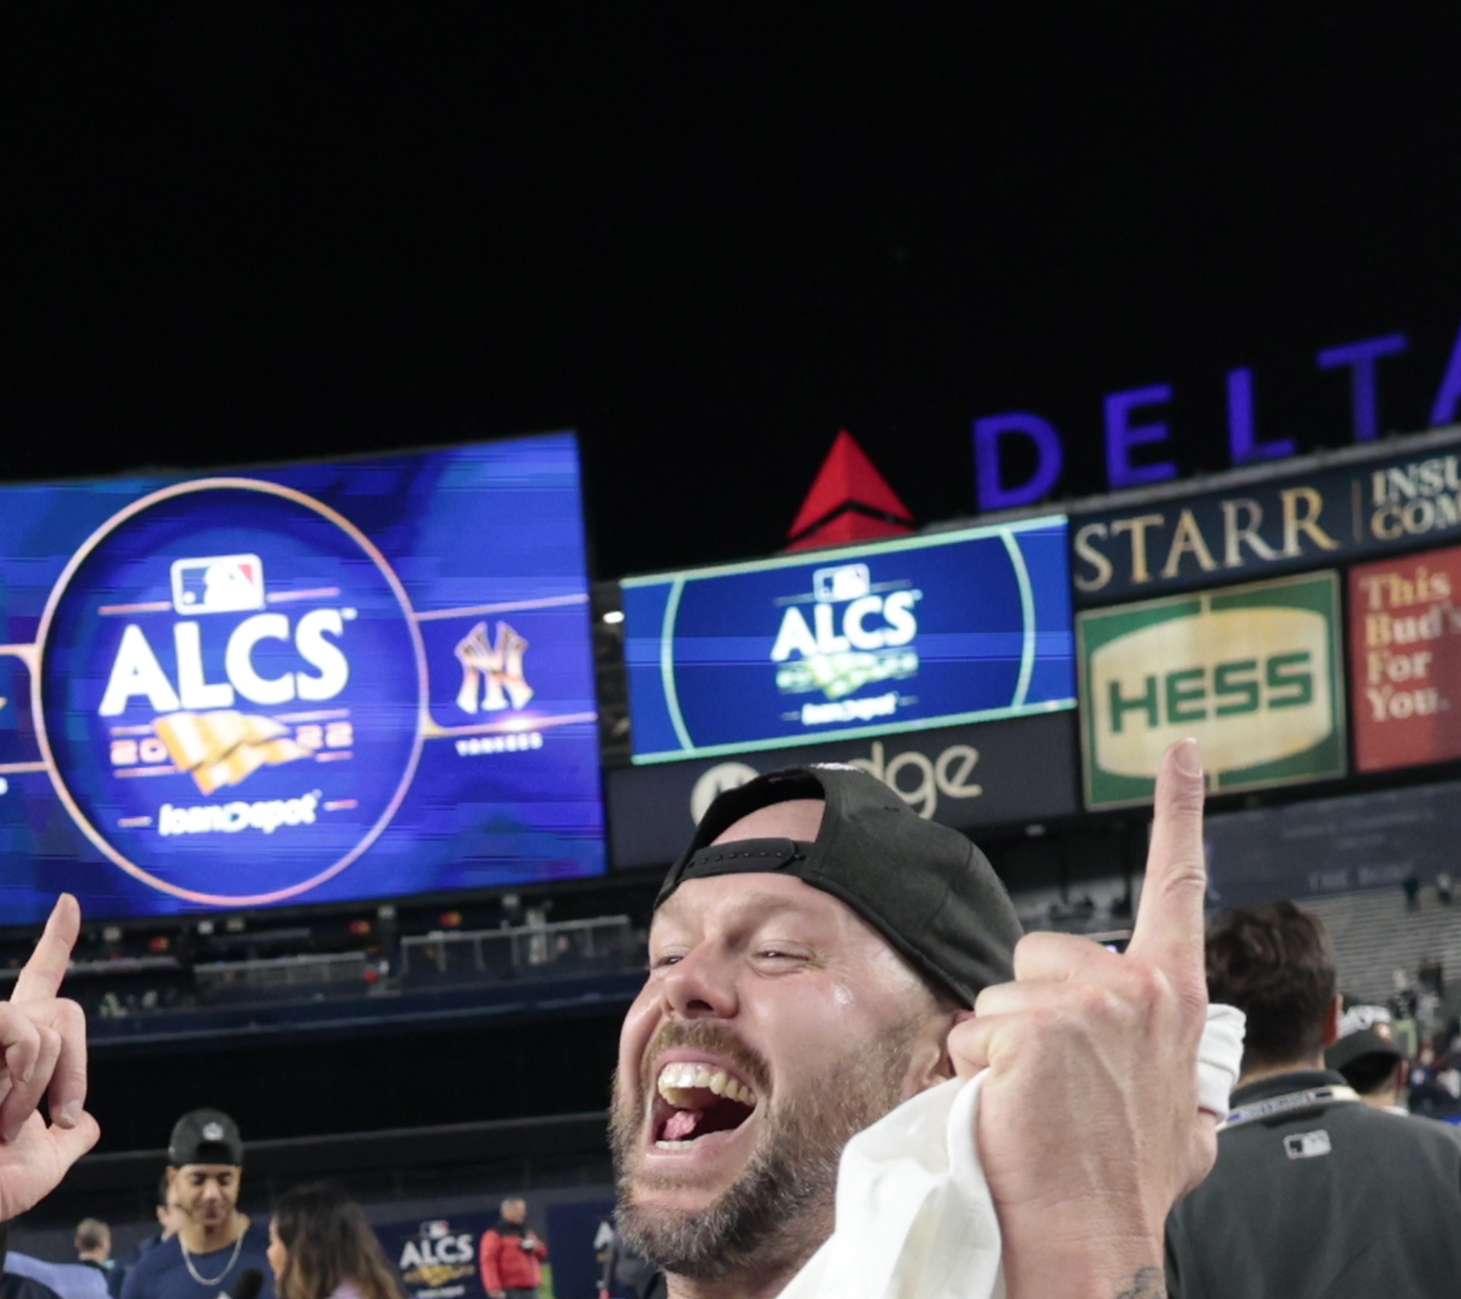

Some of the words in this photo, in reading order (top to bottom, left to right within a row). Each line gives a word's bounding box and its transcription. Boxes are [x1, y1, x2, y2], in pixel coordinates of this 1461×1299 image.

[1073, 487, 1341, 592] STARR
[1359, 567, 1451, 609] This
[770, 590, 918, 662] ALCS
[98, 608, 350, 716] ALCS
[1366, 647, 1432, 682] For
[1107, 652, 1313, 734] HESS
[1366, 684, 1449, 724] You.
[454, 731, 544, 758] YANKEES
[399, 1233, 475, 1270] ALCS
